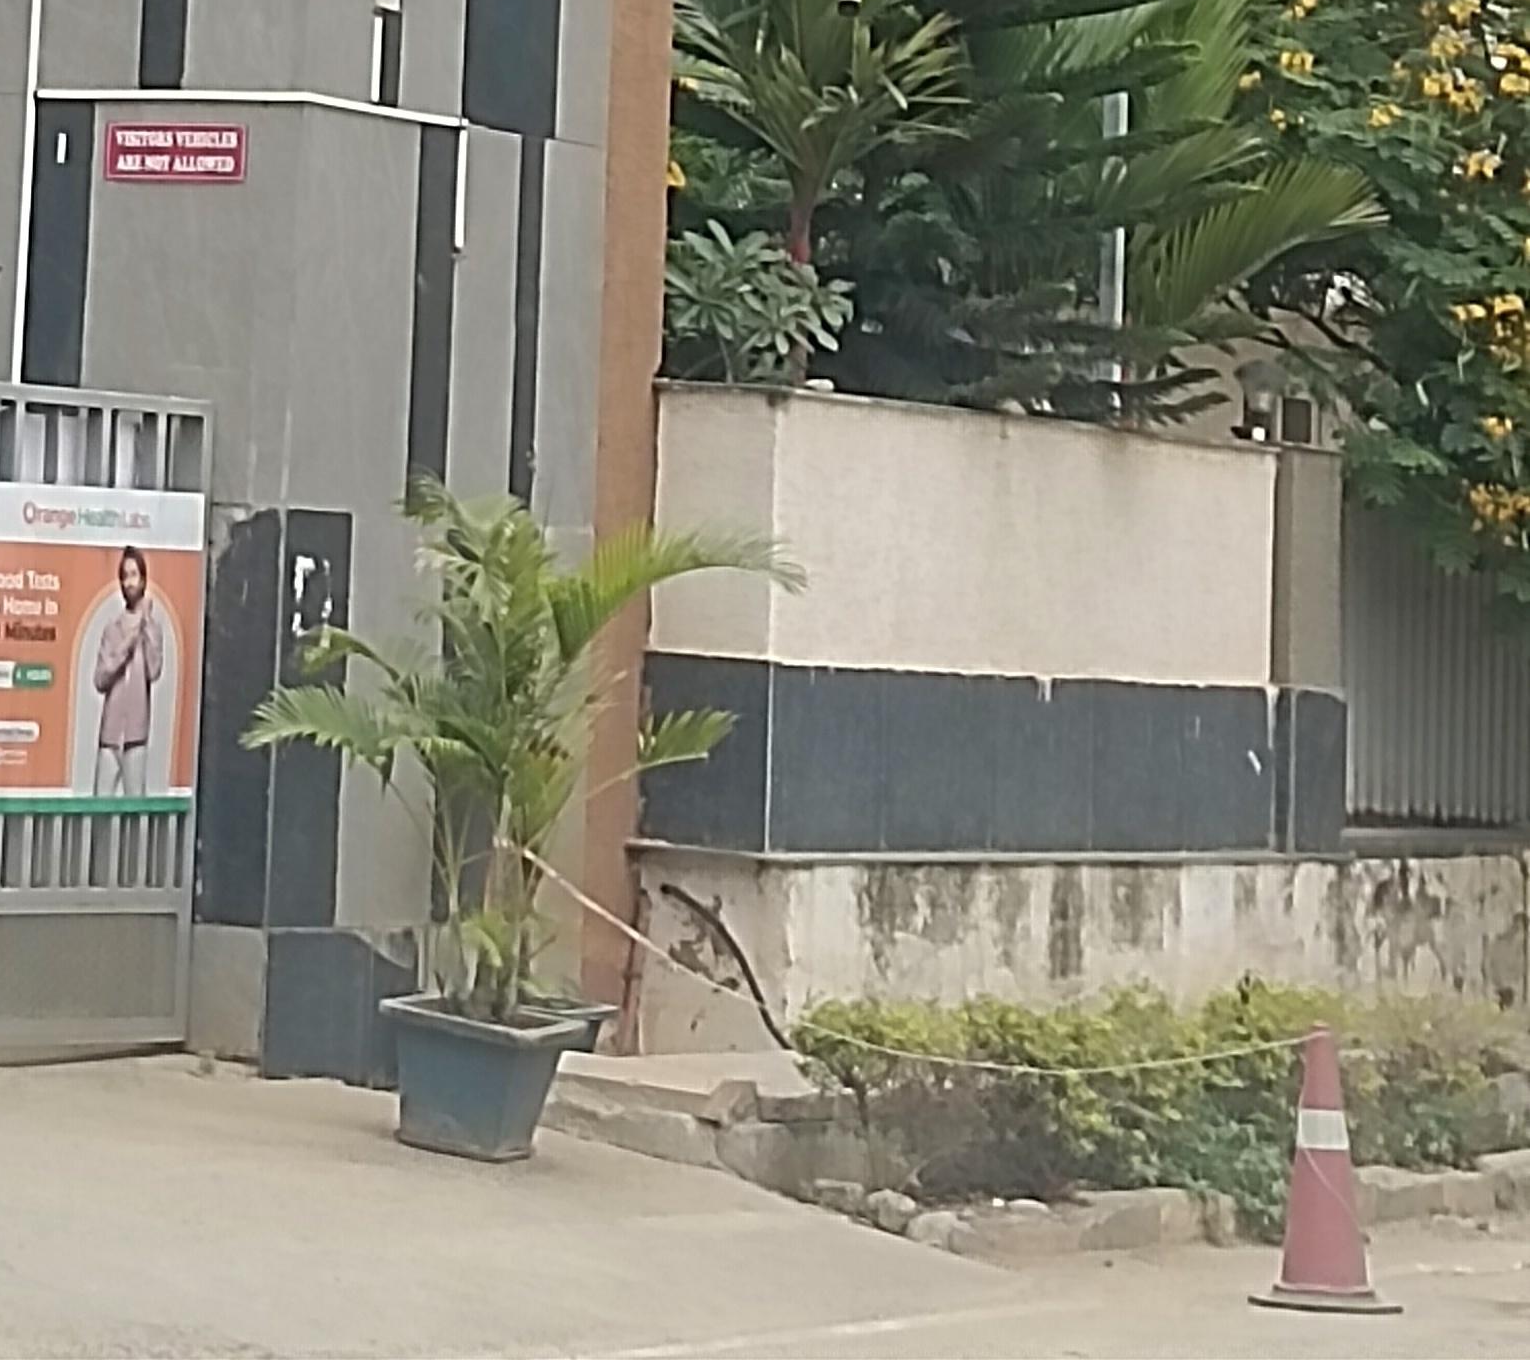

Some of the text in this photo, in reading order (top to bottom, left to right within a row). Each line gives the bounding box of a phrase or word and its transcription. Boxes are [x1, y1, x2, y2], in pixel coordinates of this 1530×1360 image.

[144, 155, 169, 170] NOT
[172, 156, 235, 172] ALLOWED
[5, 621, 56, 642] Minutes
